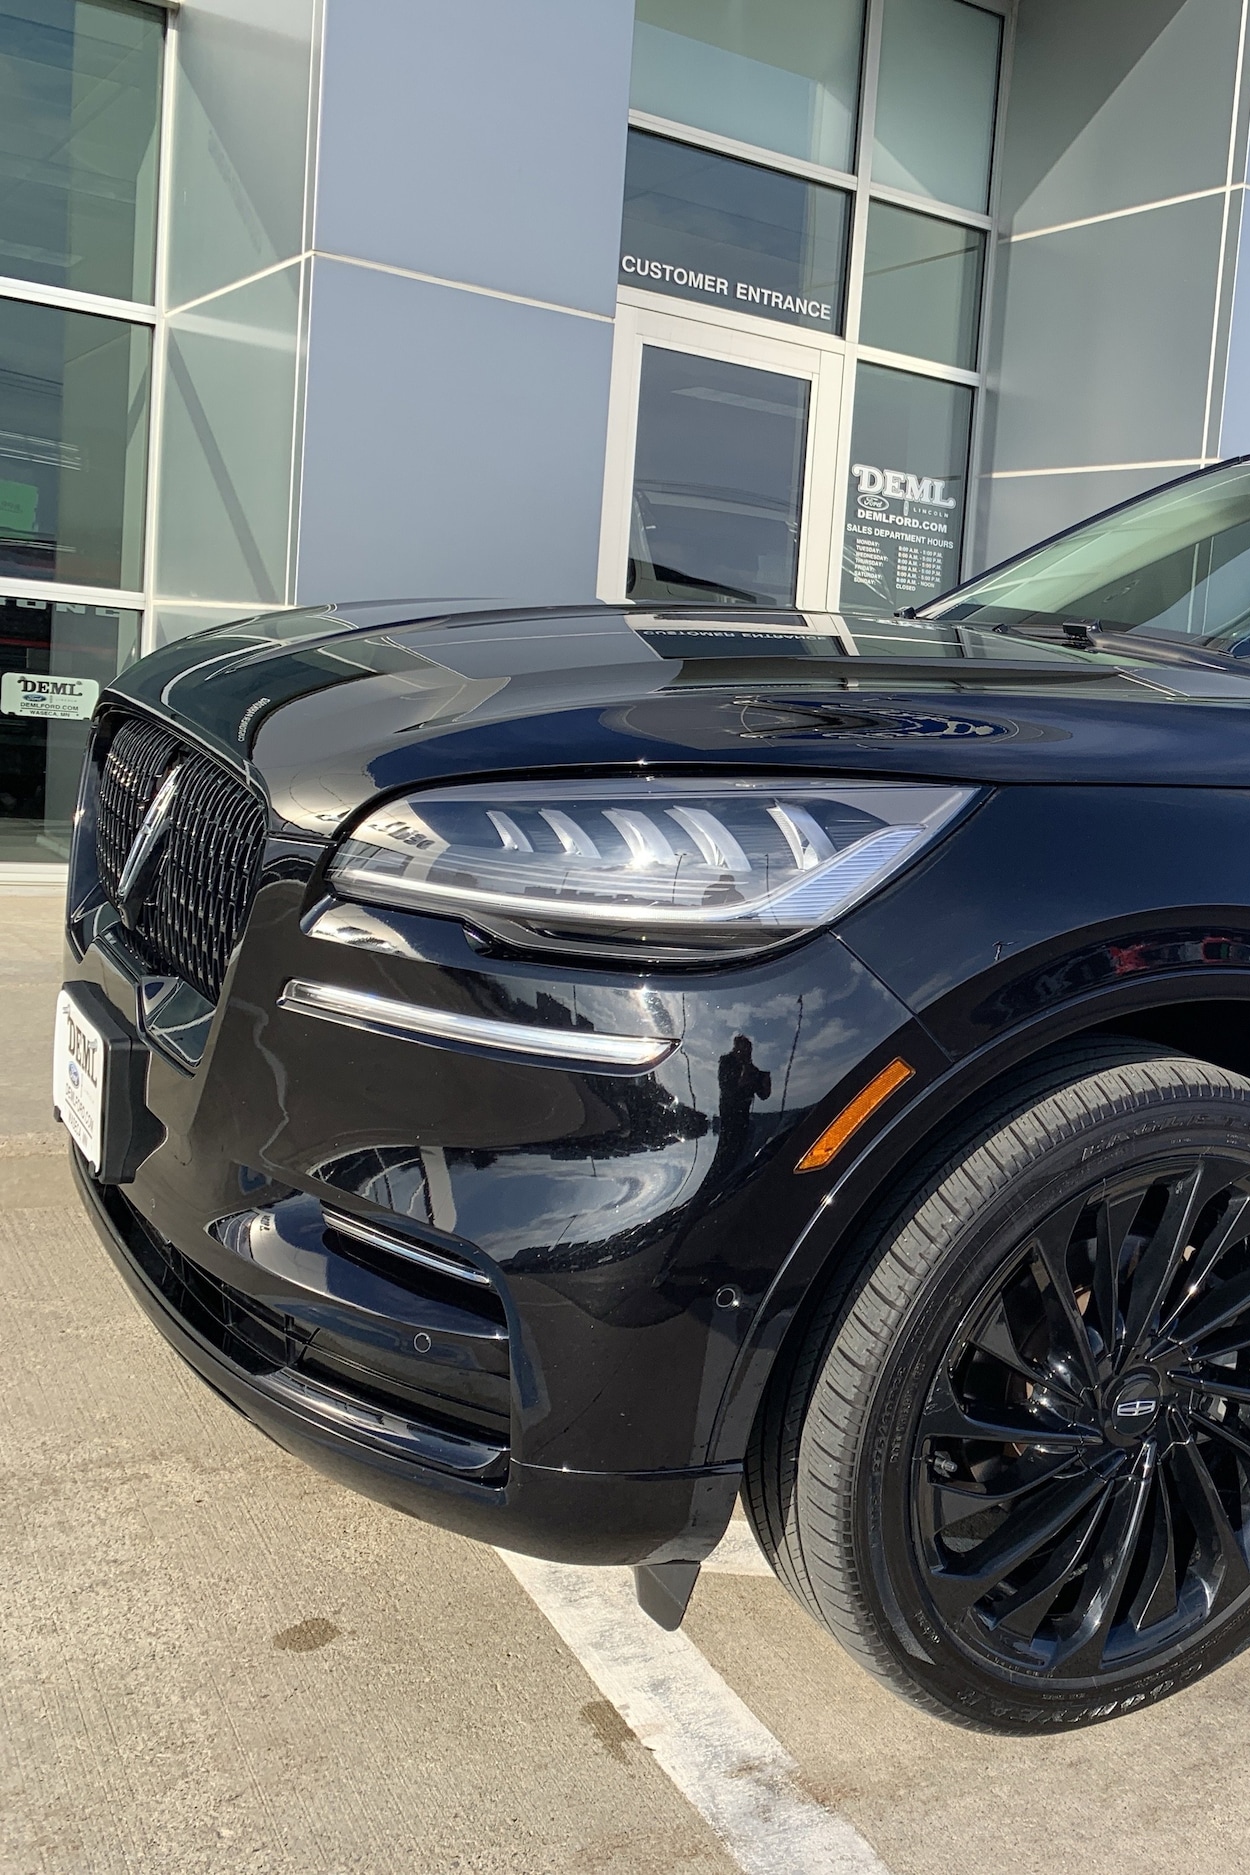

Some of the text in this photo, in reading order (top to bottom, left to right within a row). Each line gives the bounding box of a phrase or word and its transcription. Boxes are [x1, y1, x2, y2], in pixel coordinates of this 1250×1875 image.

[621, 255, 831, 321] CUSTOMER ENTRANCE
[852, 463, 957, 509] DEML
[857, 509, 948, 533] DEMLFORD.COM
[913, 507, 949, 518] LINCOLN
[847, 523, 954, 549] SALES DEPARTMENT HOURS
[17, 680, 83, 696] DEML
[67, 1016, 97, 1088] DEML
